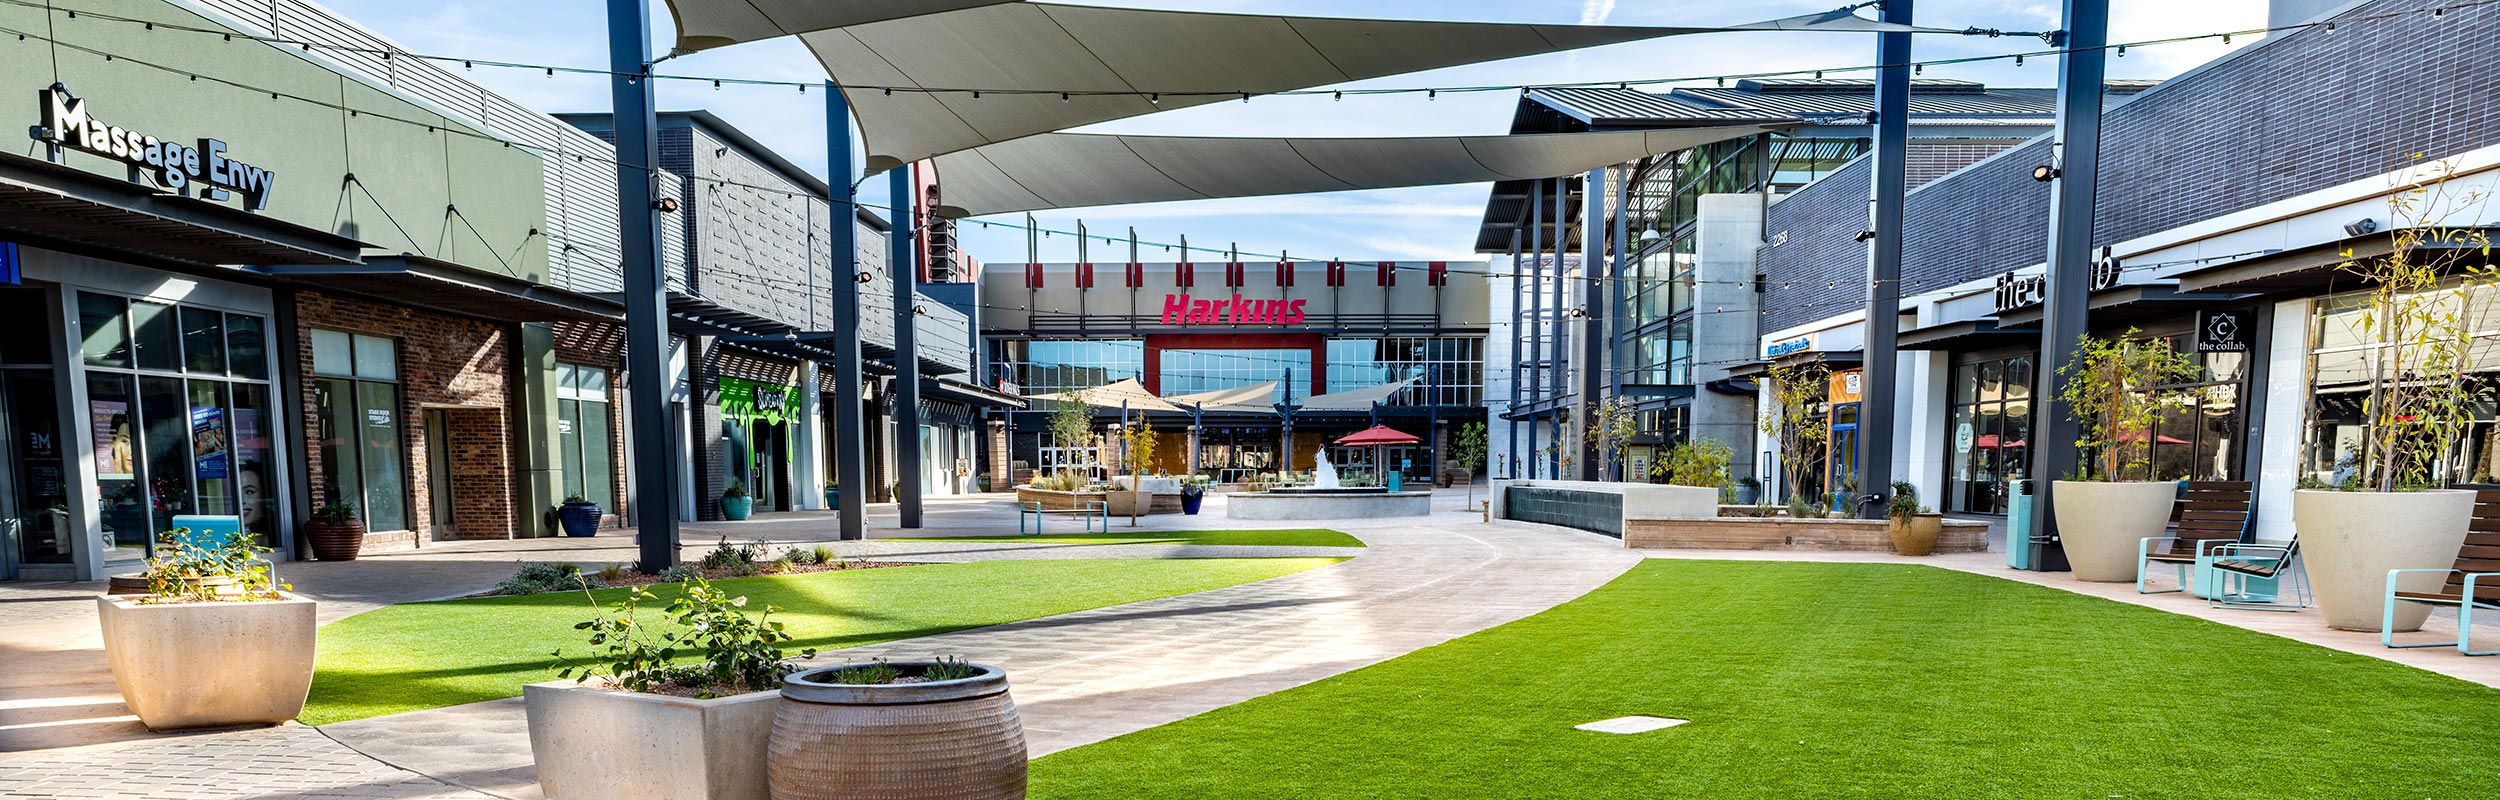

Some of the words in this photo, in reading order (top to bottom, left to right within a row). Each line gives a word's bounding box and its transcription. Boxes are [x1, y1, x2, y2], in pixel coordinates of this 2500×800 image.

[48, 89, 201, 189] Massage
[206, 138, 275, 211] Envy
[1773, 230, 1788, 247] 2268
[1993, 272, 2028, 313] the
[1161, 293, 1307, 325] Harkins
[2199, 341, 2214, 350] the
[2216, 341, 2245, 351] collab
